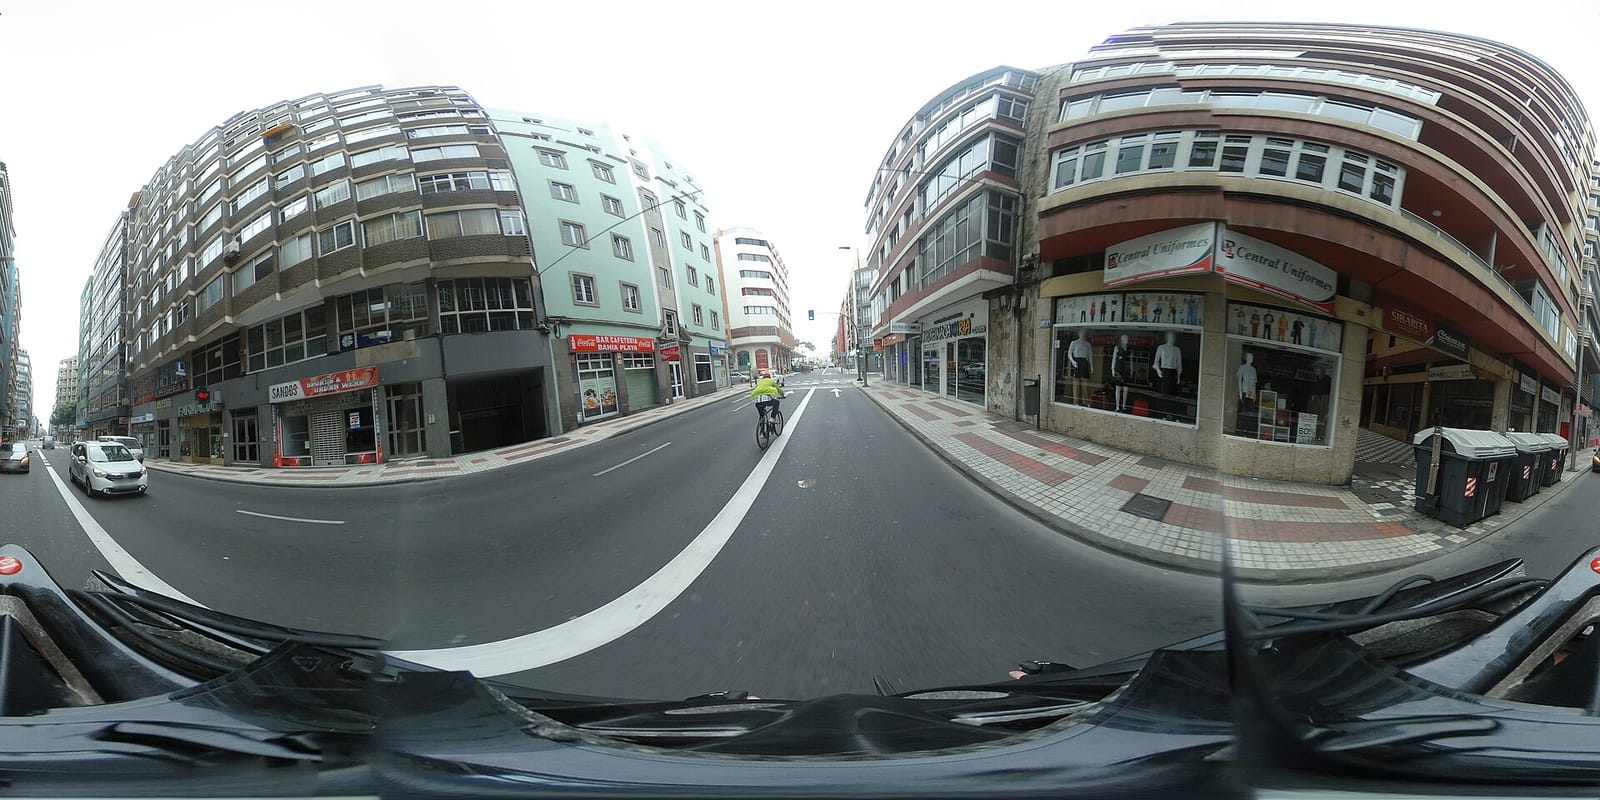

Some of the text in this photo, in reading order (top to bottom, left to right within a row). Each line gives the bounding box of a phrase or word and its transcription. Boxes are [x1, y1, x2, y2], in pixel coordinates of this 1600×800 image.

[1118, 237, 1209, 263] Central Uniformes
[1236, 246, 1333, 291] Central Uniformes
[1391, 311, 1429, 336] SIBARITA
[272, 384, 298, 400] SANDOS
